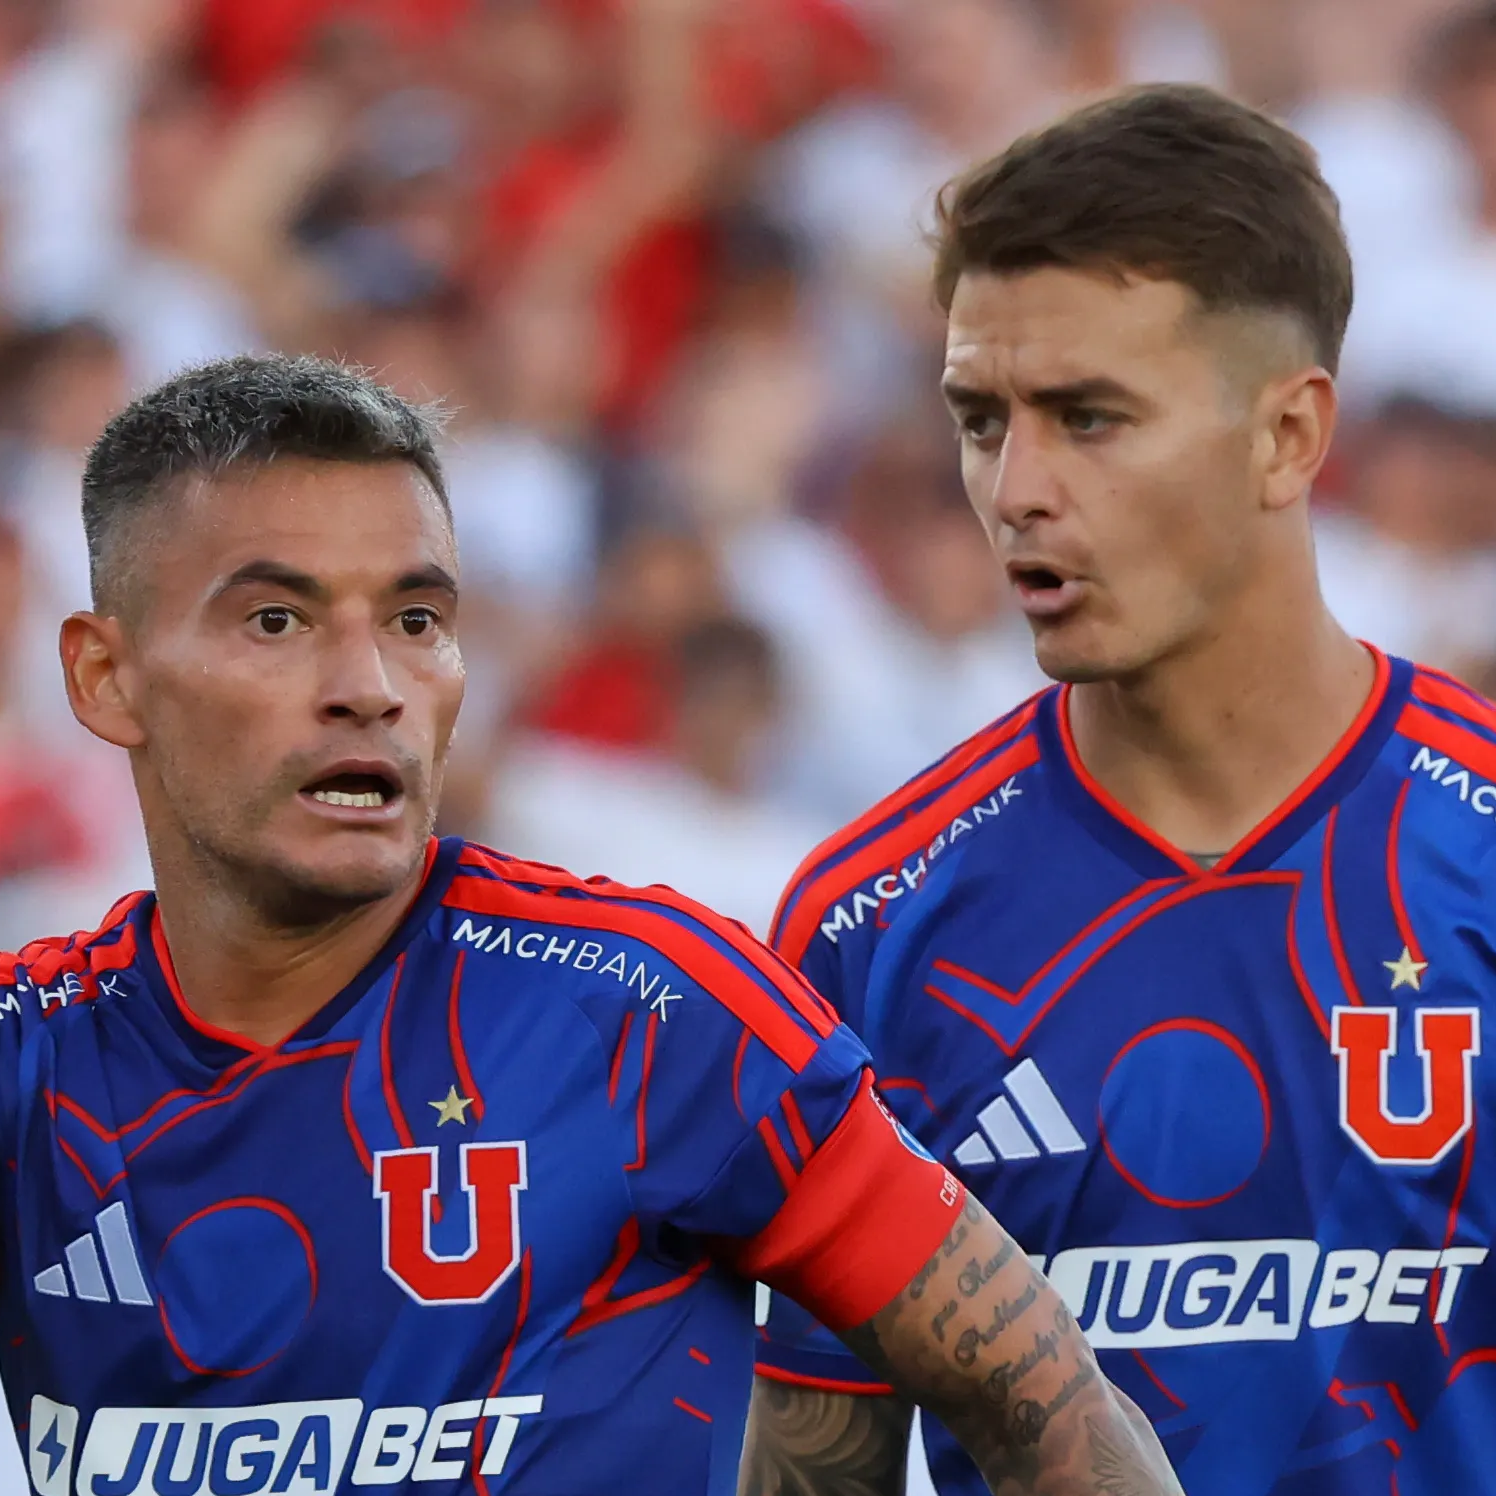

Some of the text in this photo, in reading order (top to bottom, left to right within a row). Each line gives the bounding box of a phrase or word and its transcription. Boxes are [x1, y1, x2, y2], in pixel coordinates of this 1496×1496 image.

[452, 918, 684, 1023] MACHBANK
[1331, 1007, 1480, 1164] U
[374, 1140, 527, 1305] U
